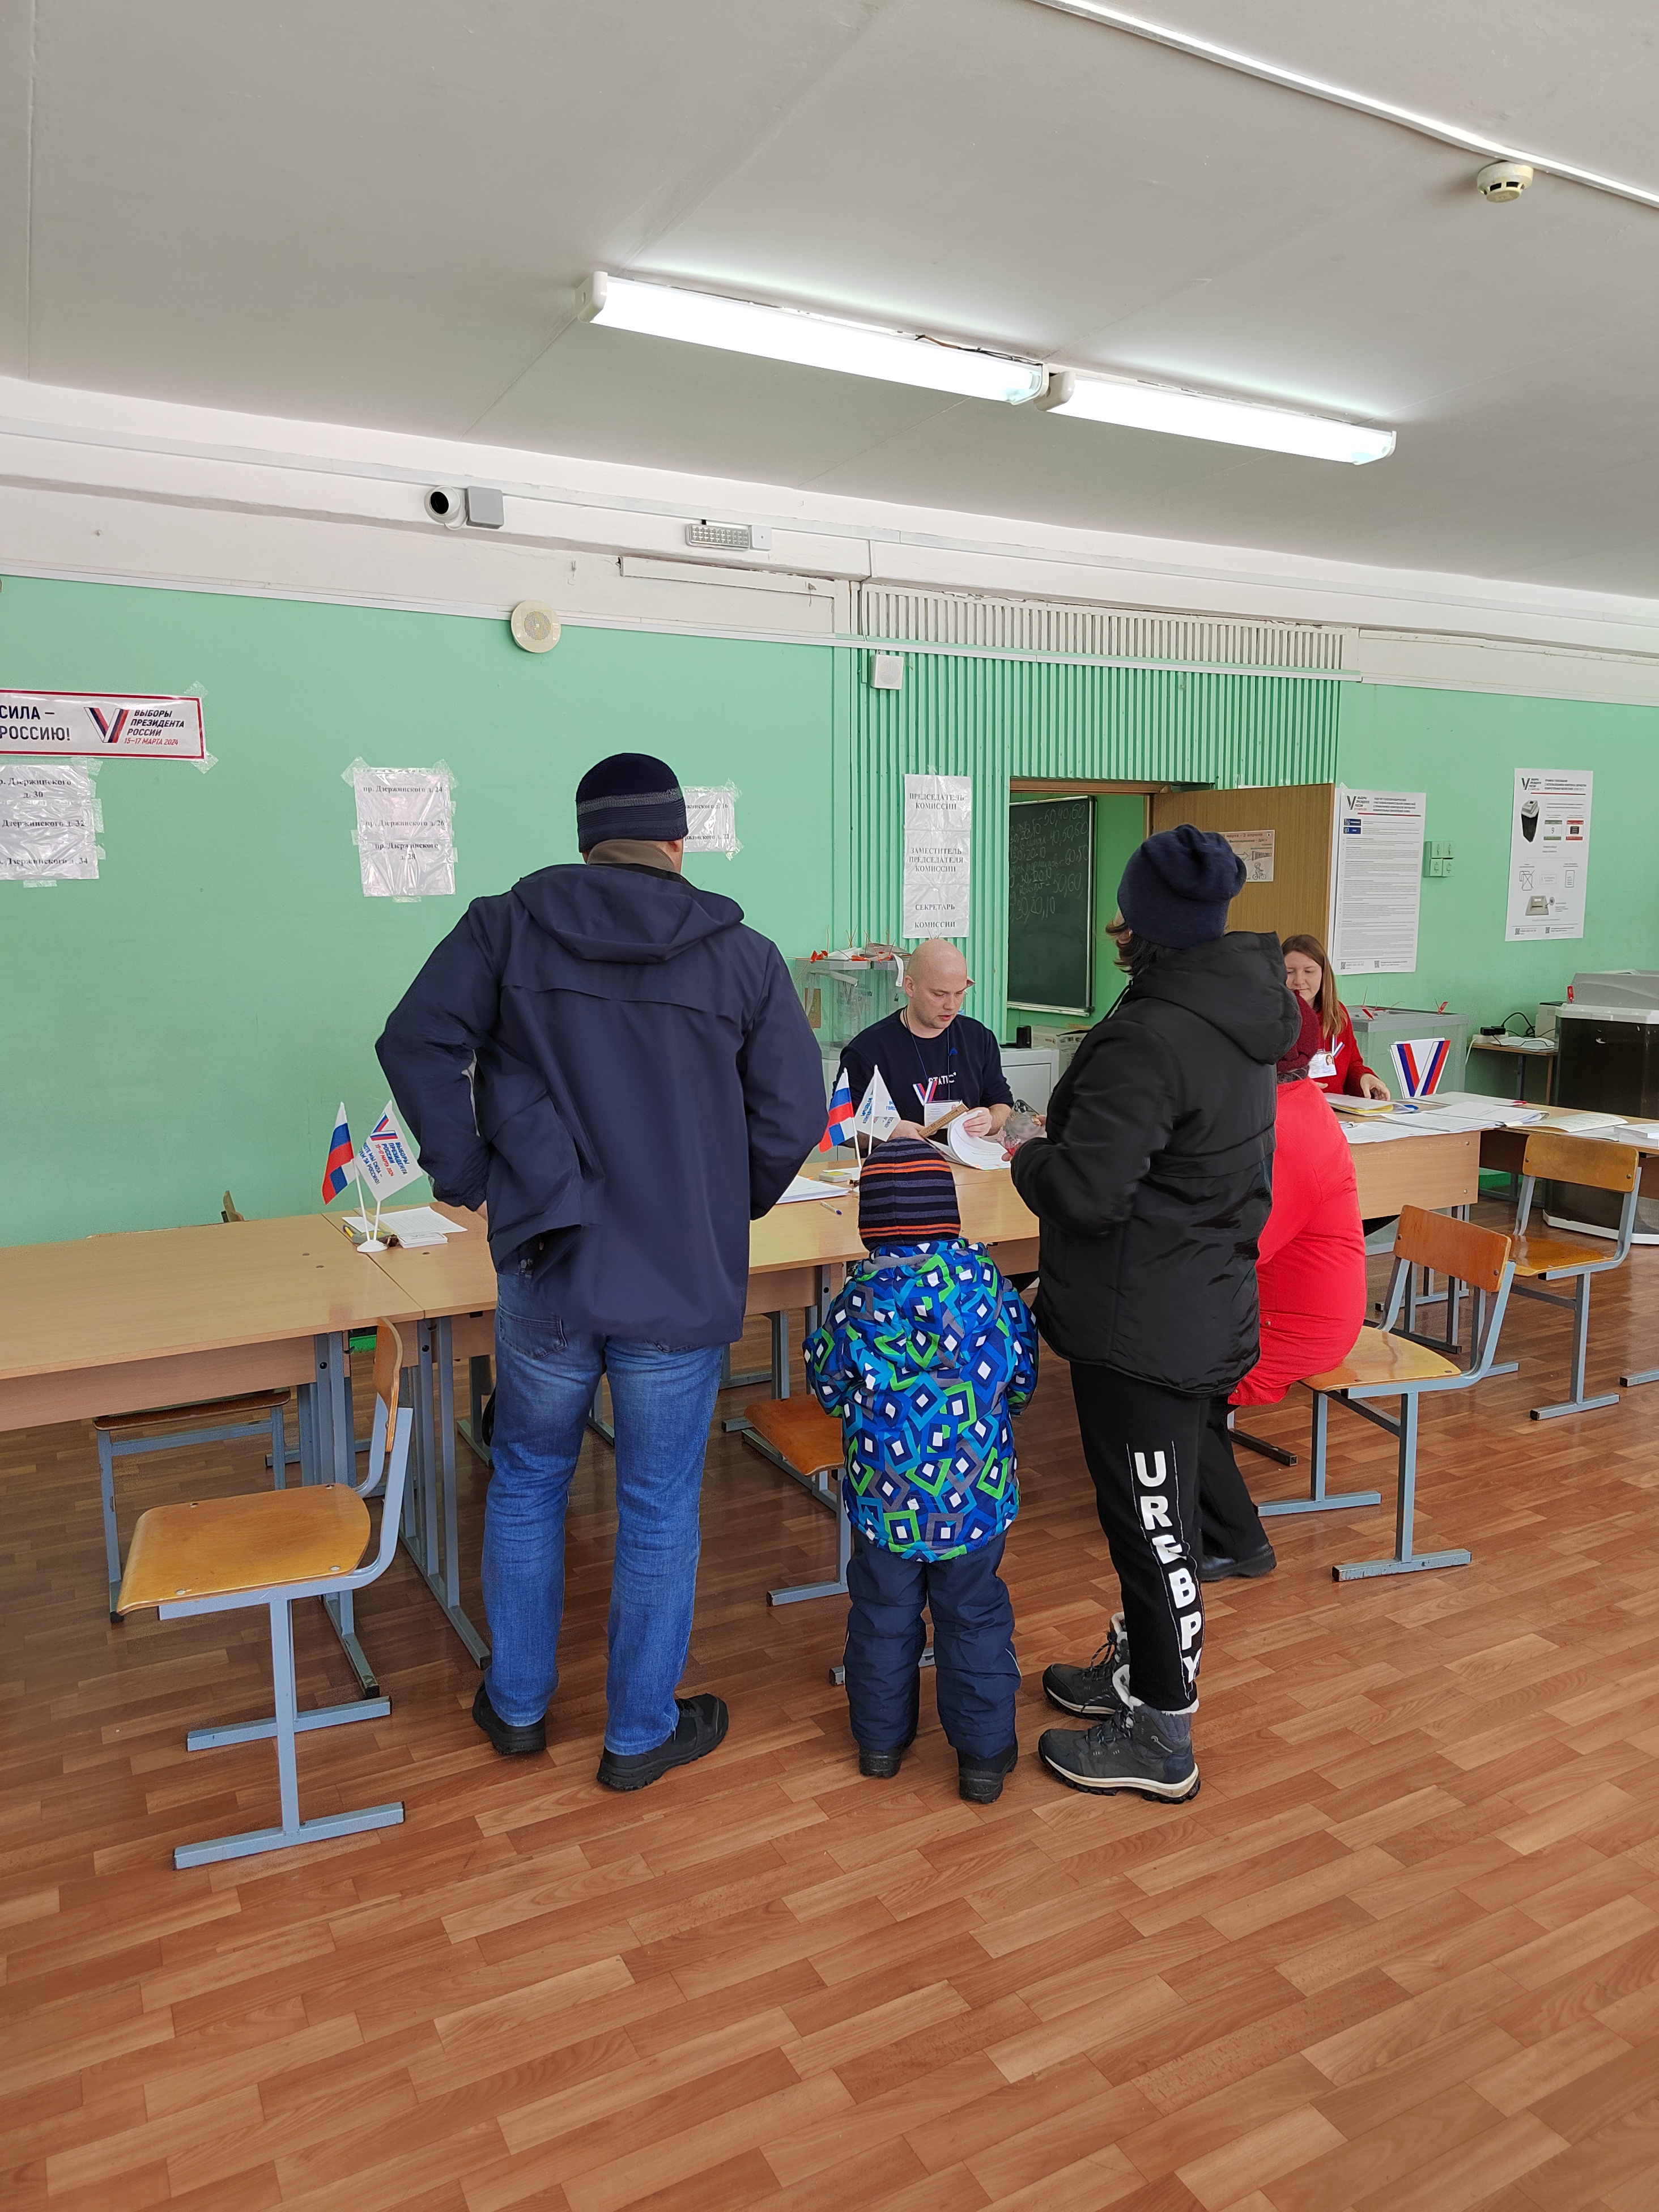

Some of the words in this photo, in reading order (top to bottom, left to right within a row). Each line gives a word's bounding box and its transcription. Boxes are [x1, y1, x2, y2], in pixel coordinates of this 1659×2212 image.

[0, 705, 41, 720] СИЛА
[130, 718, 184, 728] ПРЕЗИДЕНТА
[0, 725, 70, 741] РОССИЮ!
[127, 728, 162, 737] РОССИИ
[8, 777, 71, 788] Дзержинского
[2, 819, 64, 828] Дзержинского
[6, 857, 67, 866] Дзержинского
[368, 1152, 376, 1162] МЫ
[381, 1143, 395, 1164] РОССИИ
[388, 1142, 407, 1175] ПРЕЗИДЕНТА
[395, 1142, 410, 1165] ВЫБОРЫ
[380, 1155, 389, 1167] МАРТА
[367, 1164, 380, 1185] РОССИЮ!
[1135, 1451, 1202, 1682] UREBPY
